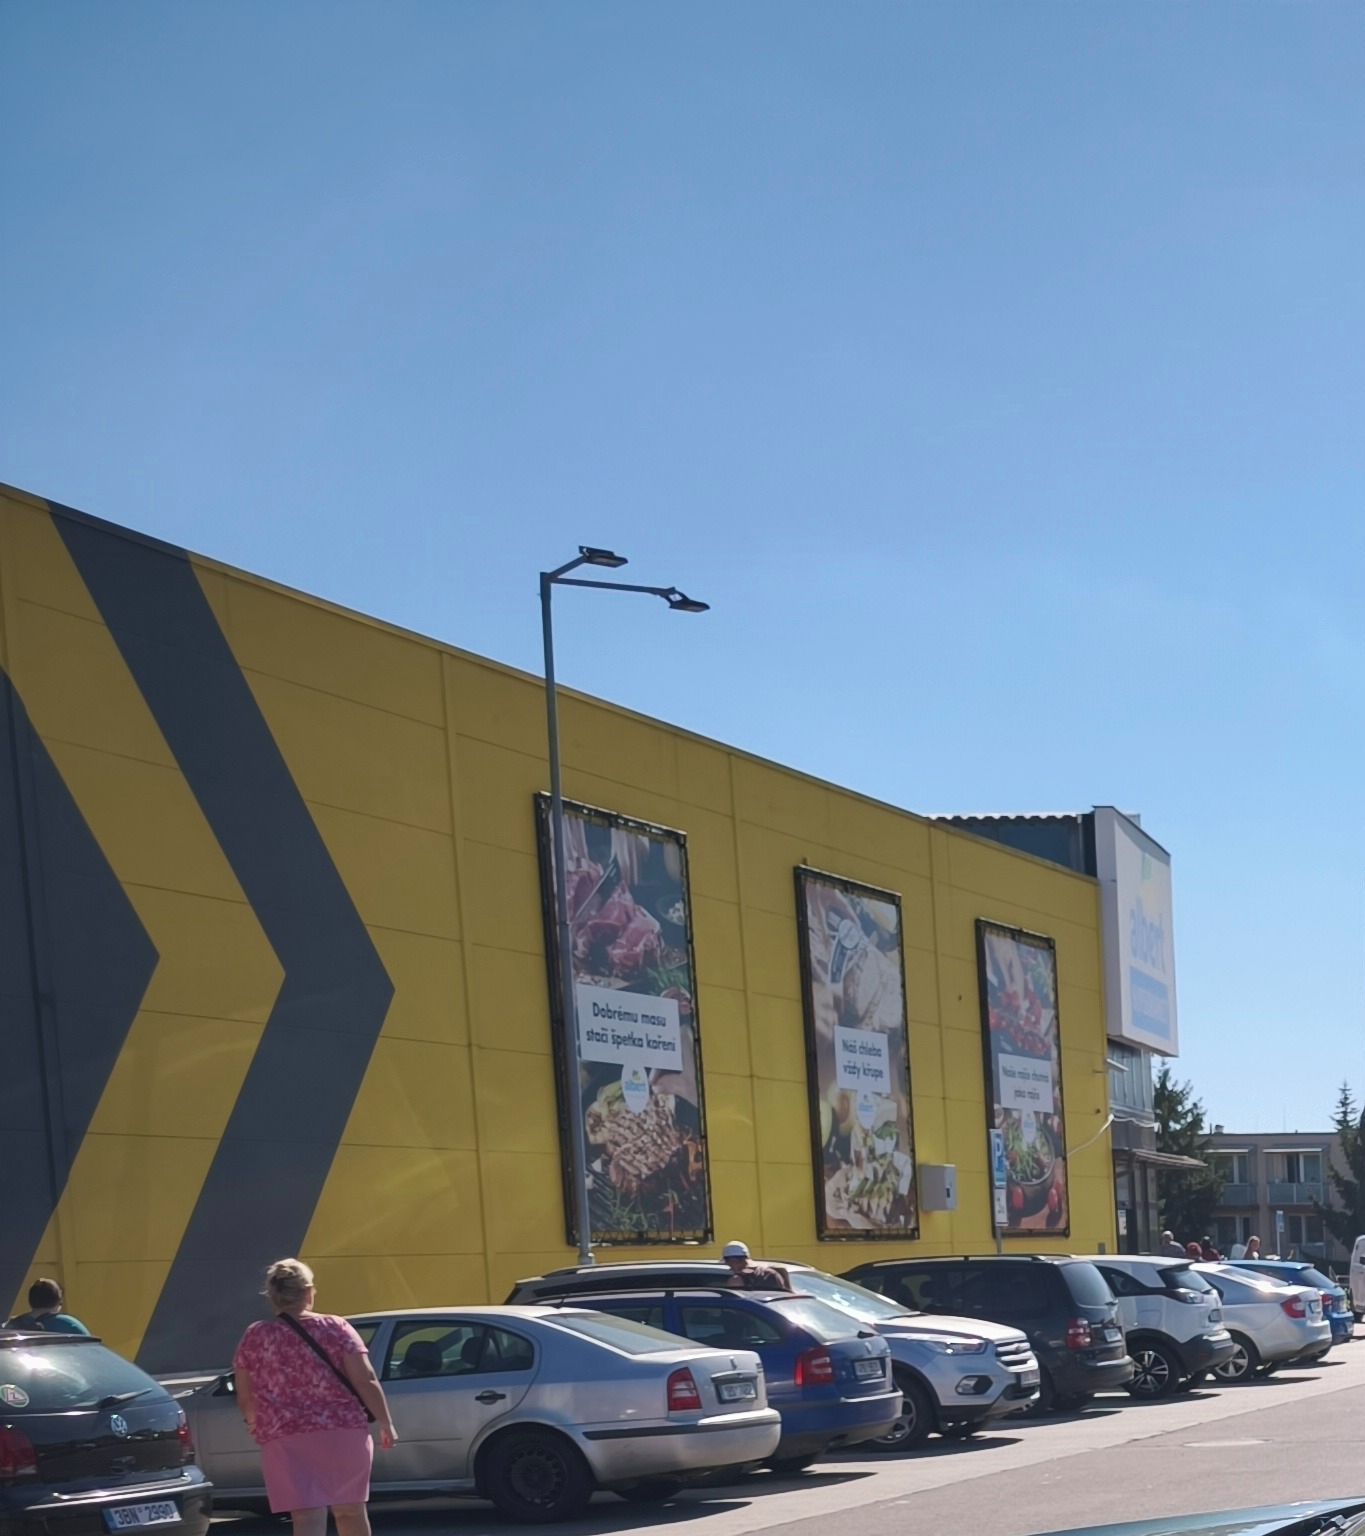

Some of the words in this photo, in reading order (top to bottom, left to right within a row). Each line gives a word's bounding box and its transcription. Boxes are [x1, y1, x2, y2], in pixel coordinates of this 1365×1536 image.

[1130, 894, 1165, 975] albert
[592, 1001, 638, 1023] Dobrému
[641, 1013, 666, 1027] masu
[611, 1029, 644, 1049] špetka
[646, 1033, 676, 1051] koření
